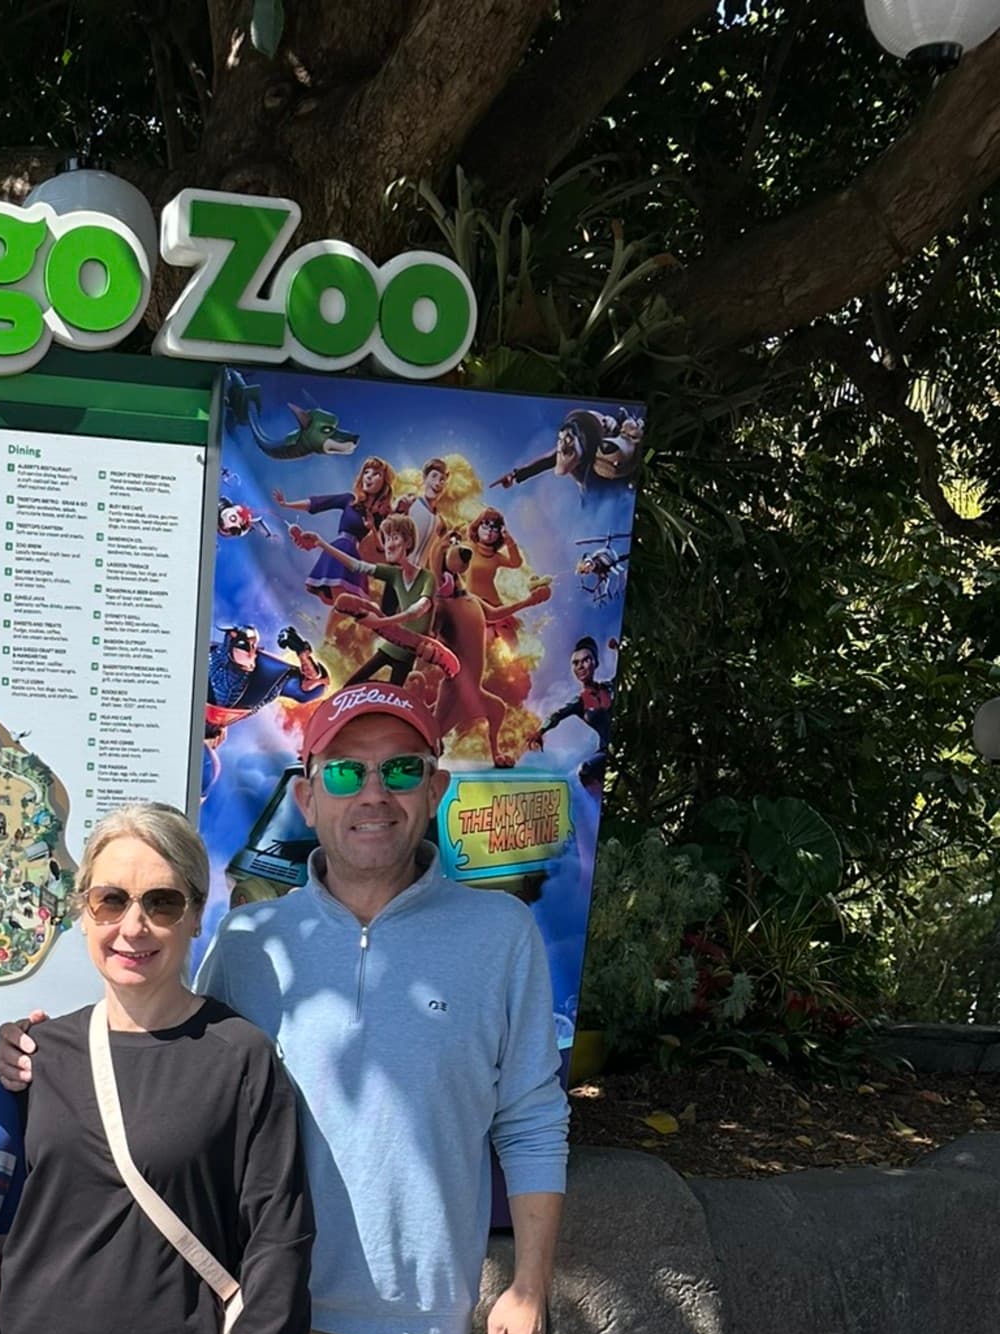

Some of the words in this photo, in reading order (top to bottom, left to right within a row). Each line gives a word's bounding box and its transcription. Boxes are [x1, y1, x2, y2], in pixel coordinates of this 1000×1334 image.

[182, 200, 470, 366] Zoo
[8, 444, 41, 458] Dining
[328, 687, 413, 720] Titleist
[459, 806, 493, 834] THE
[492, 789, 560, 829] MYSTERY
[489, 815, 559, 854] MACHINE
